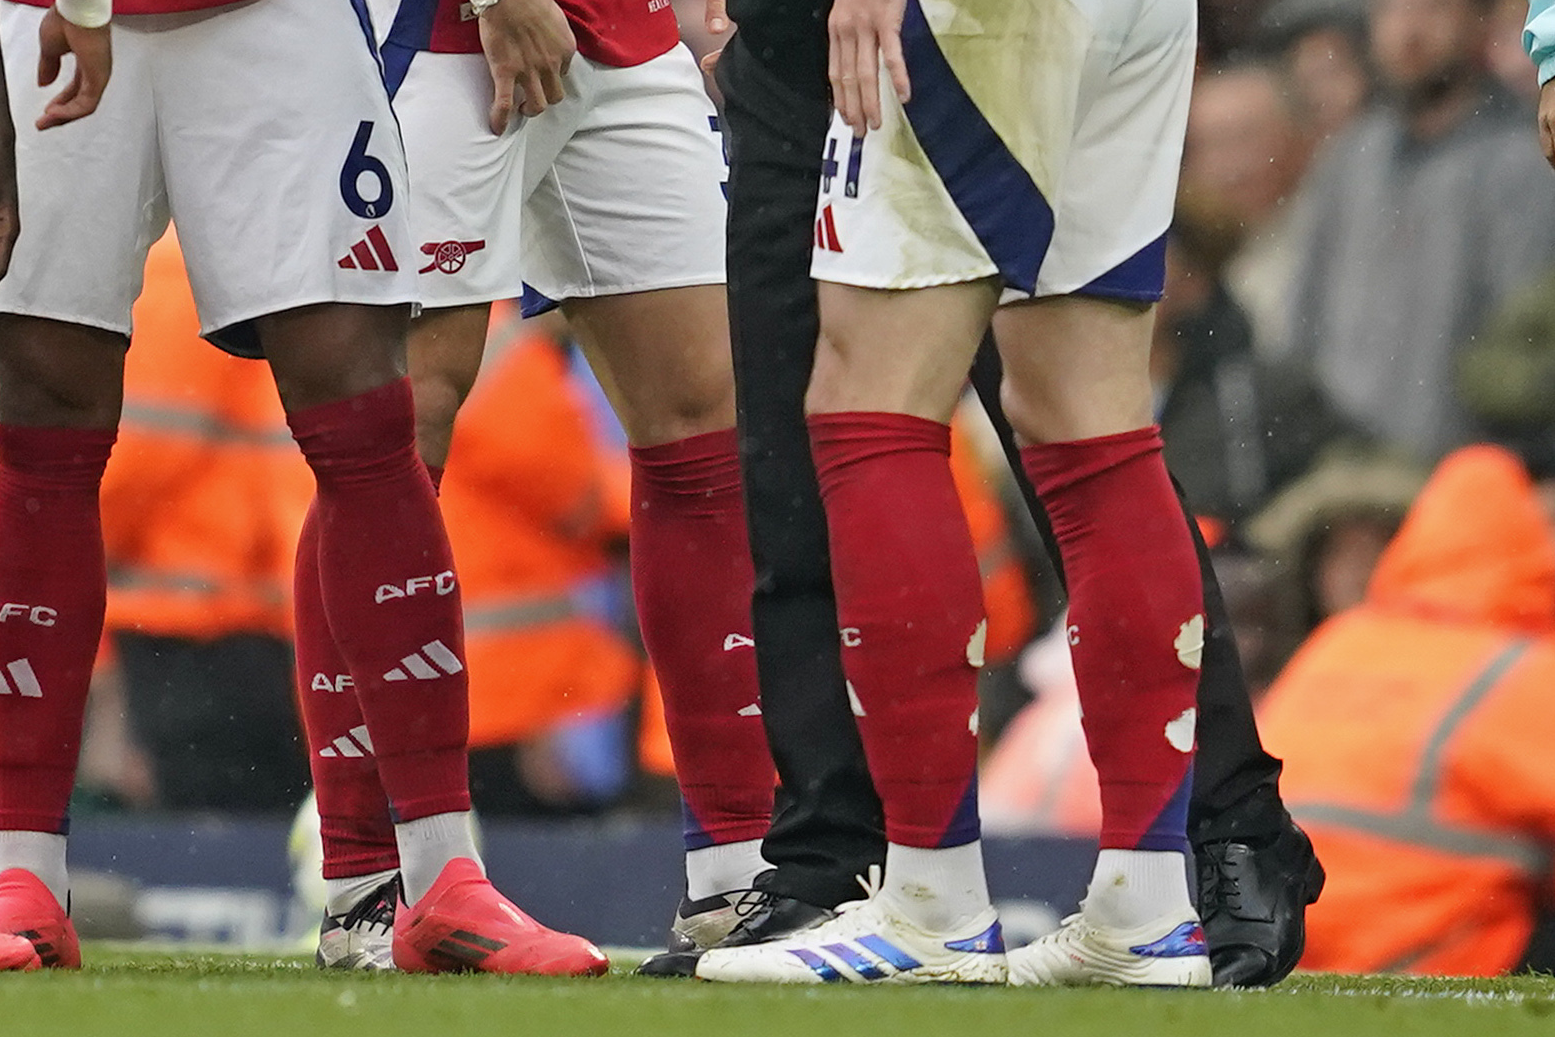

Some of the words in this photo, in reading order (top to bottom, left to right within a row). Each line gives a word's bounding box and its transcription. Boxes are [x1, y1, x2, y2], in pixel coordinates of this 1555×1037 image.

[339, 120, 393, 219] 6
[375, 571, 455, 604] AFC
[311, 672, 355, 692] AF
